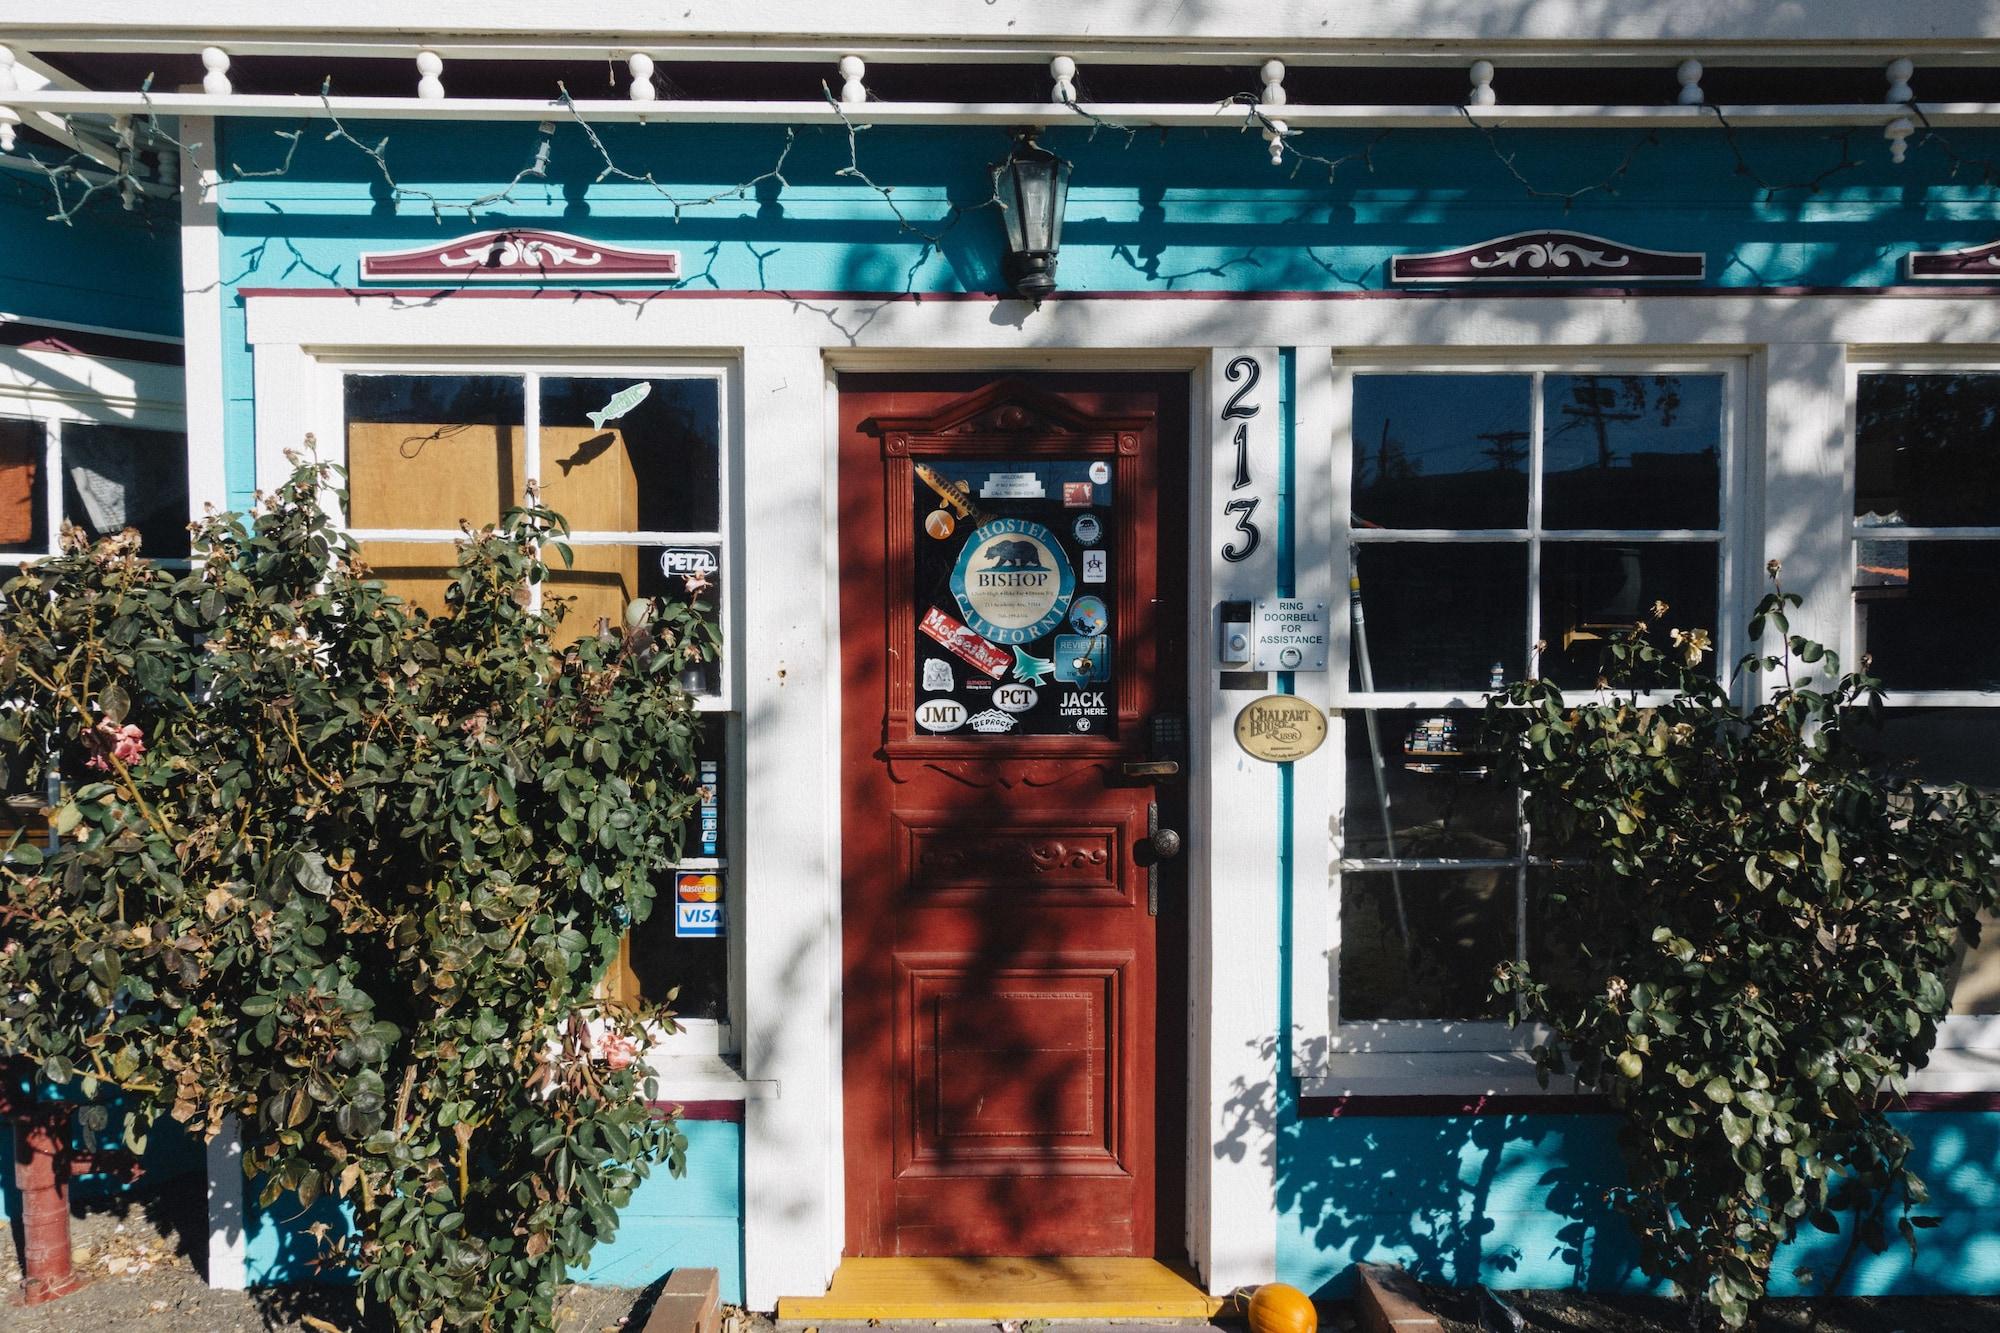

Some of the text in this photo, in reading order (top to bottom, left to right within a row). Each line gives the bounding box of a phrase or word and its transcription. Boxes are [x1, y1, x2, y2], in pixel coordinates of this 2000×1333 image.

[976, 519, 1047, 542] HOSTEL
[663, 552, 718, 578] PETZL
[979, 573, 1048, 587] BISHOP
[1280, 602, 1304, 611] RING
[956, 594, 1070, 642] CALIFORNIA
[1264, 612, 1318, 621] DOORBELL
[1281, 624, 1302, 633] FOR
[1260, 636, 1323, 644] ASSISTANCE
[1000, 689, 1032, 704] PCT
[1060, 692, 1105, 708] JACK
[922, 706, 960, 723] JMT
[1060, 708, 1082, 716] LIVES
[1249, 706, 1311, 721] CHALFANT
[974, 718, 1012, 729] BEDROCK
[684, 909, 722, 922] VISA
